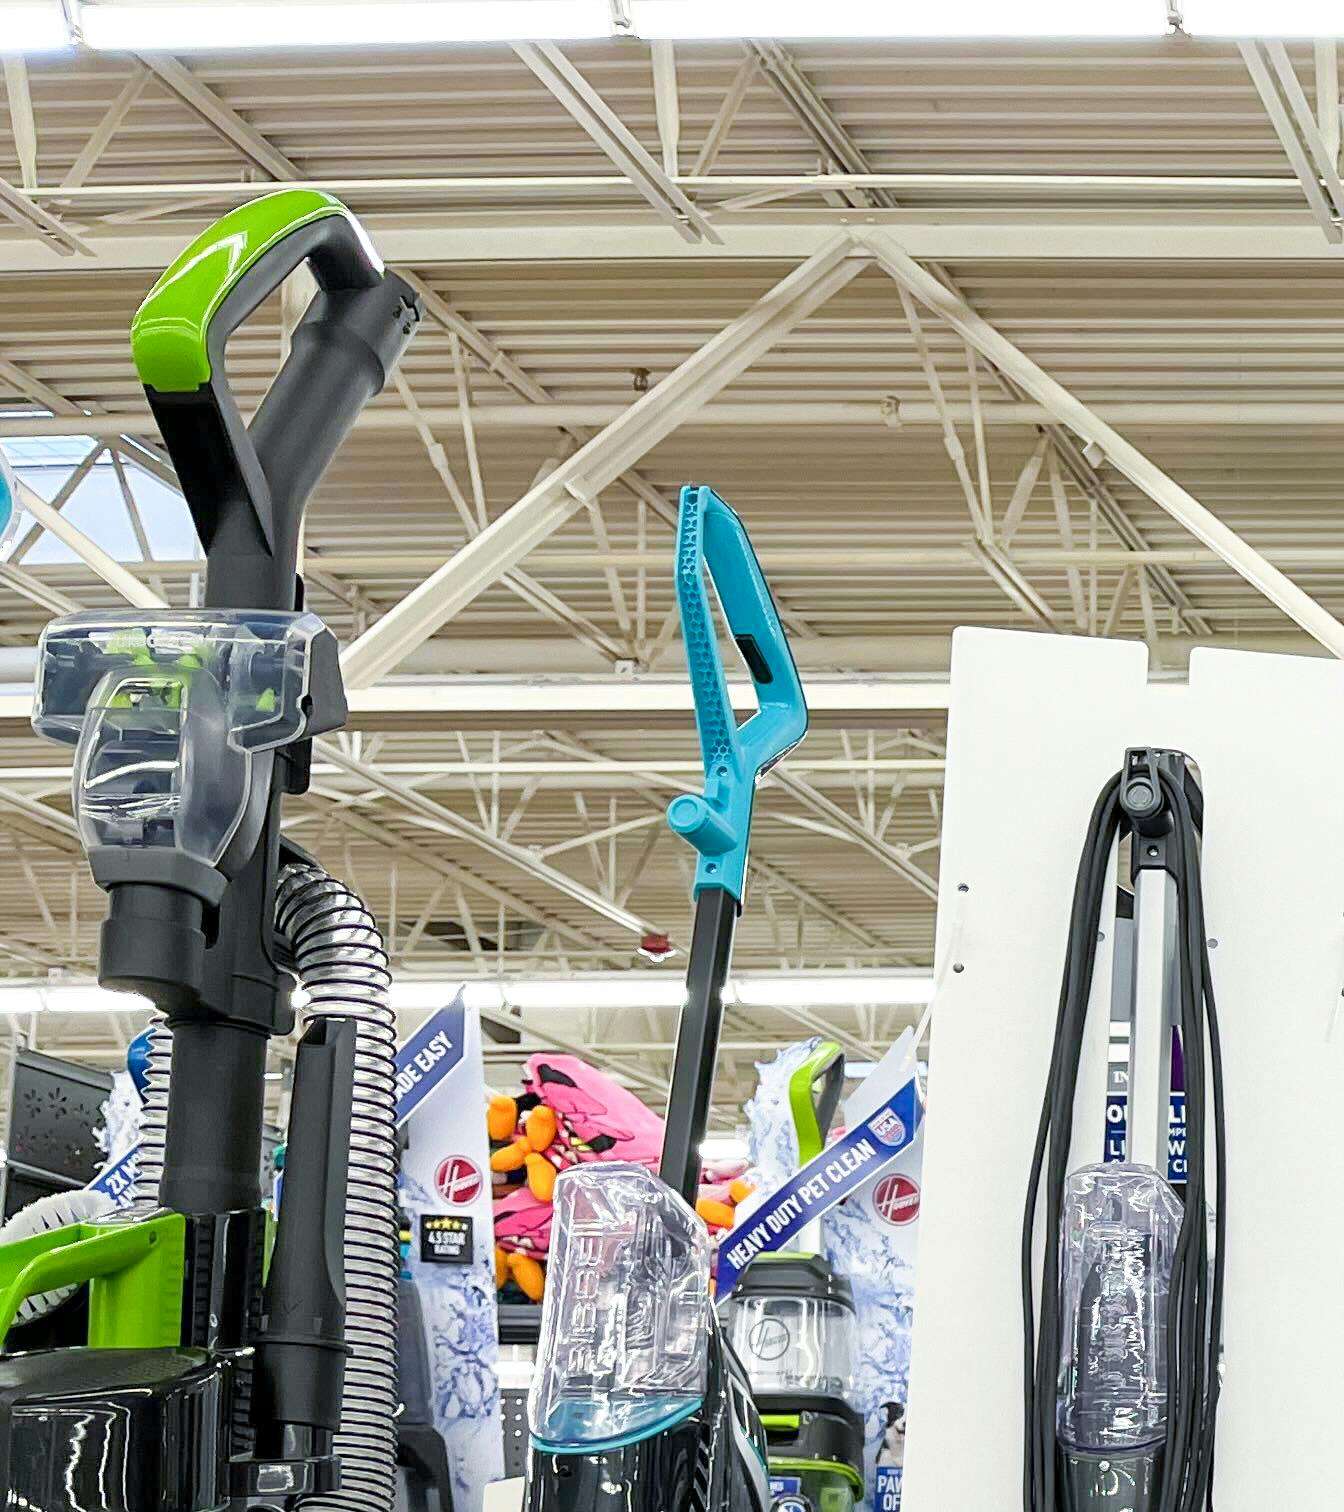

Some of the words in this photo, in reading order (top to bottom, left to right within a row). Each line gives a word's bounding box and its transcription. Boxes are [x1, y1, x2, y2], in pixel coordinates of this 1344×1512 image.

[418, 1031, 454, 1072] EASY
[727, 1222, 773, 1270] HEAVY
[769, 1197, 804, 1235] DUTY
[801, 1172, 832, 1205] PET
[827, 1137, 878, 1183] CLEAN
